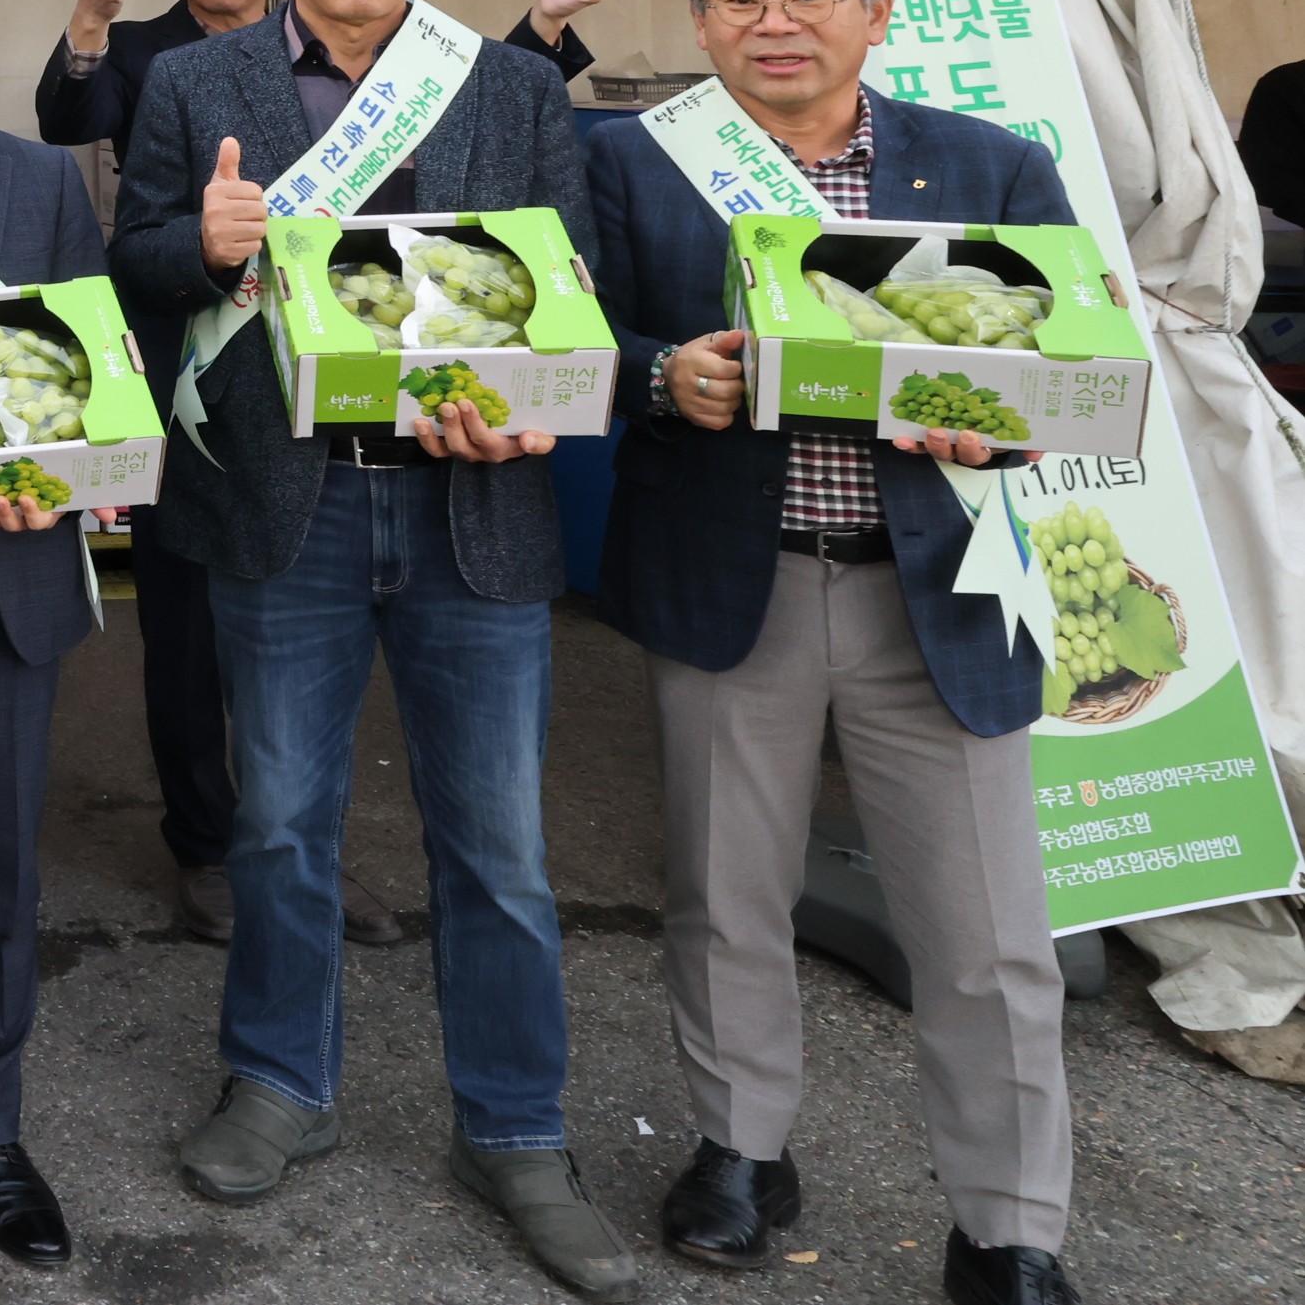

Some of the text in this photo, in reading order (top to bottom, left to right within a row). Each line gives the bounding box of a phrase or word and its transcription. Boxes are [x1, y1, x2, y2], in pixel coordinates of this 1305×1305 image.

[418, 17, 461, 56] 반딧불
[654, 90, 708, 123] 반딧불
[320, 81, 397, 173] 소비촉진
[576, 366, 599, 394] 샤인
[1101, 374, 1129, 407] 샤인
[129, 451, 150, 473] 샤인
[1098, 757, 1256, 801] 농협중앙회무주군지부
[1033, 784, 1074, 808] 주군
[1043, 834, 1242, 889] 주군농협조합공동사업법인
